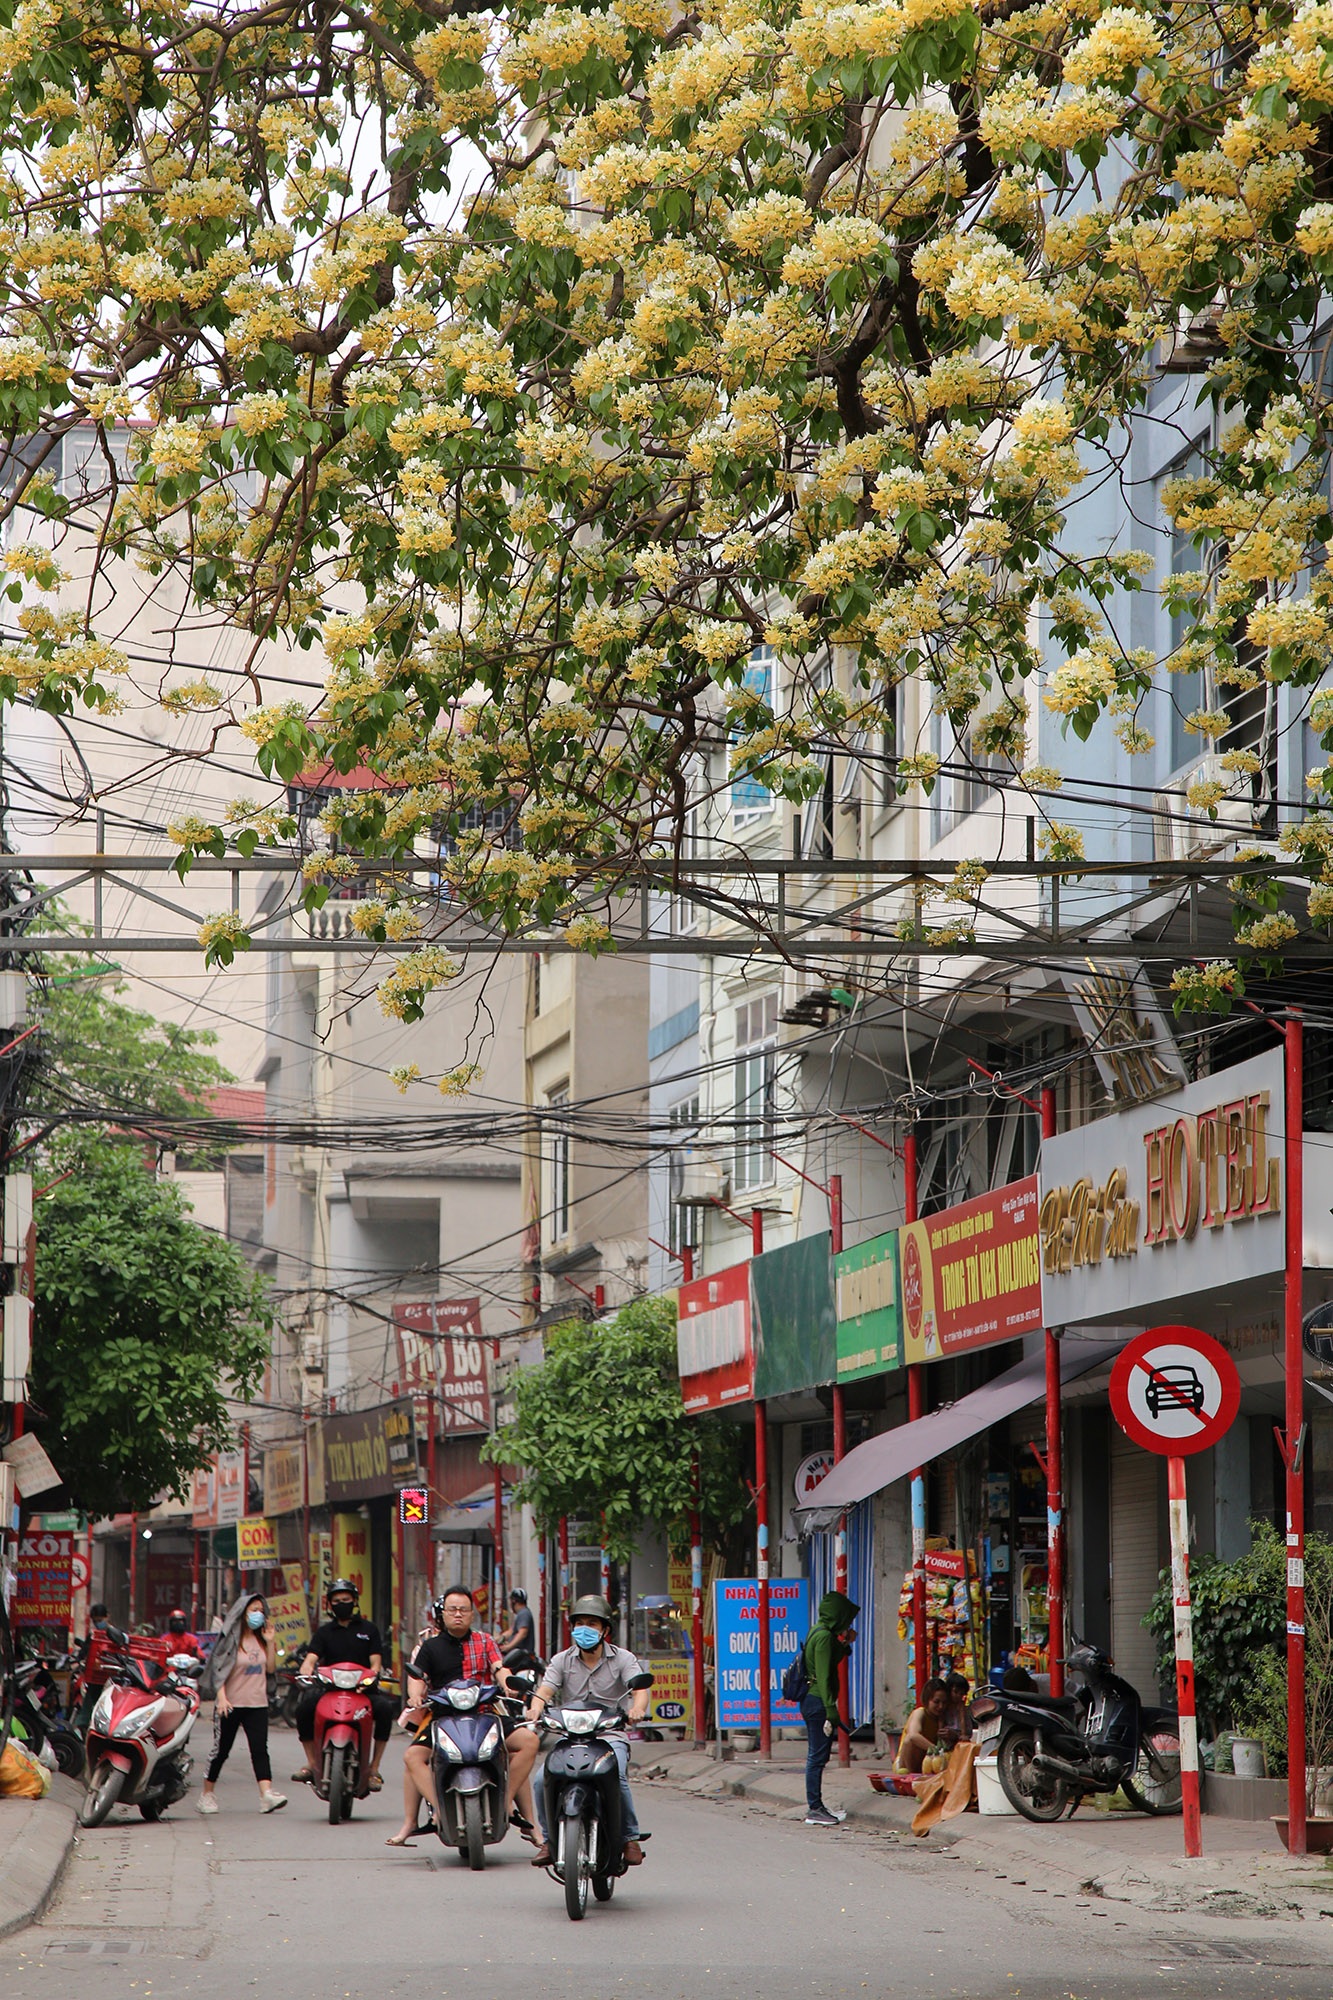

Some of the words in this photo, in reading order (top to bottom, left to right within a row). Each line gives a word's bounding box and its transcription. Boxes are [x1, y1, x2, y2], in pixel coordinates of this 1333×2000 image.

[1144, 1090, 1280, 1247] HOTEL
[942, 1228, 948, 1246] TY
[941, 1258, 966, 1320] TRỌNG
[966, 1244, 980, 1304] TRÍ
[997, 1233, 1039, 1295] HOLDINGS
[444, 1380, 484, 1397] RANG
[930, 1556, 957, 1571] ORION
[725, 1585, 757, 1600] NHÀ
[773, 1624, 798, 1653] ĐẦU
[722, 1669, 751, 1691] 150K
[660, 1704, 681, 1718] 15K
